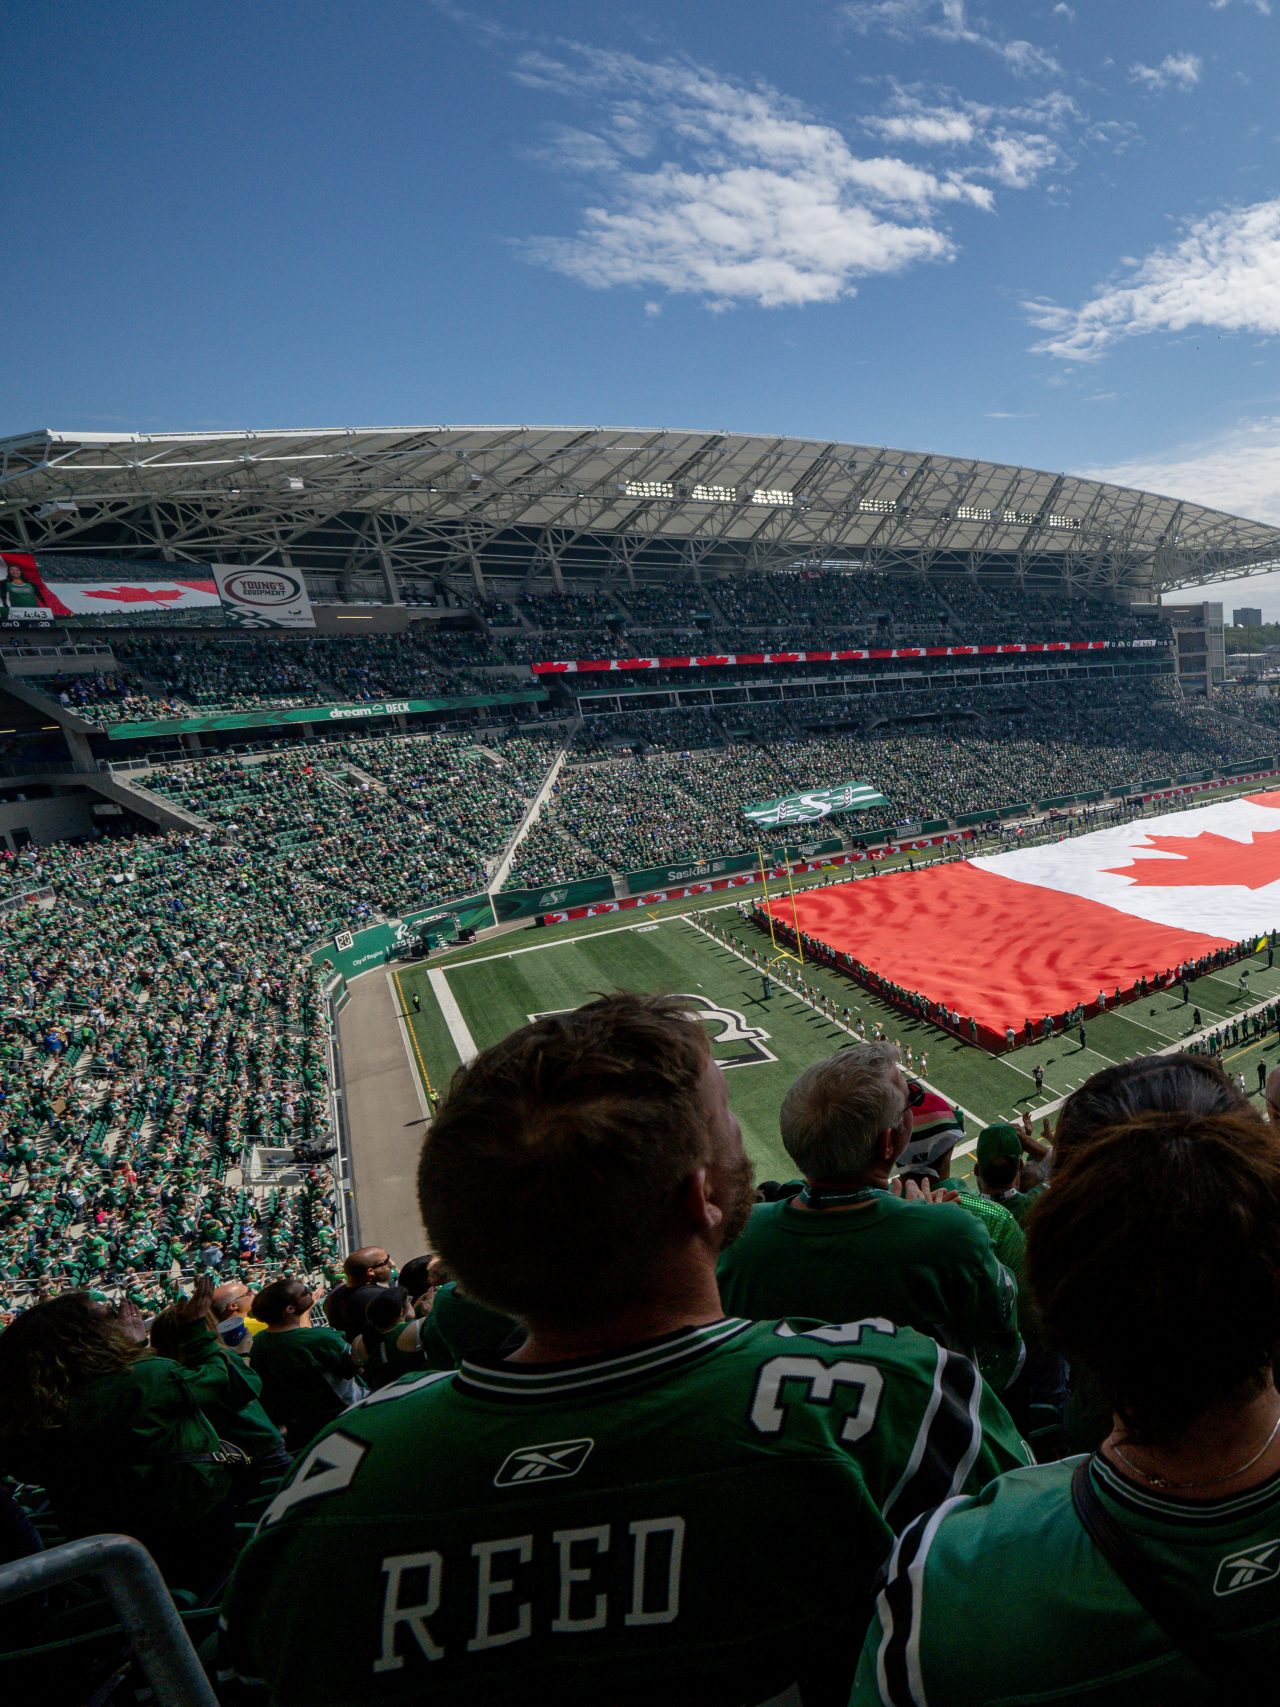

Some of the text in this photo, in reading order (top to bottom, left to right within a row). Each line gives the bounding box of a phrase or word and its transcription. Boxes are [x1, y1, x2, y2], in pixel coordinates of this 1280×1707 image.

[240, 581, 285, 591] YOUNG'S
[243, 589, 286, 597] EQUIPMENT
[24, 611, 47, 619] 4:43
[330, 703, 410, 718] dream DECK
[668, 864, 711, 881] SaskTel
[352, 959, 362, 967] City
[367, 950, 383, 961] Regina
[371, 1514, 687, 1669] REED
